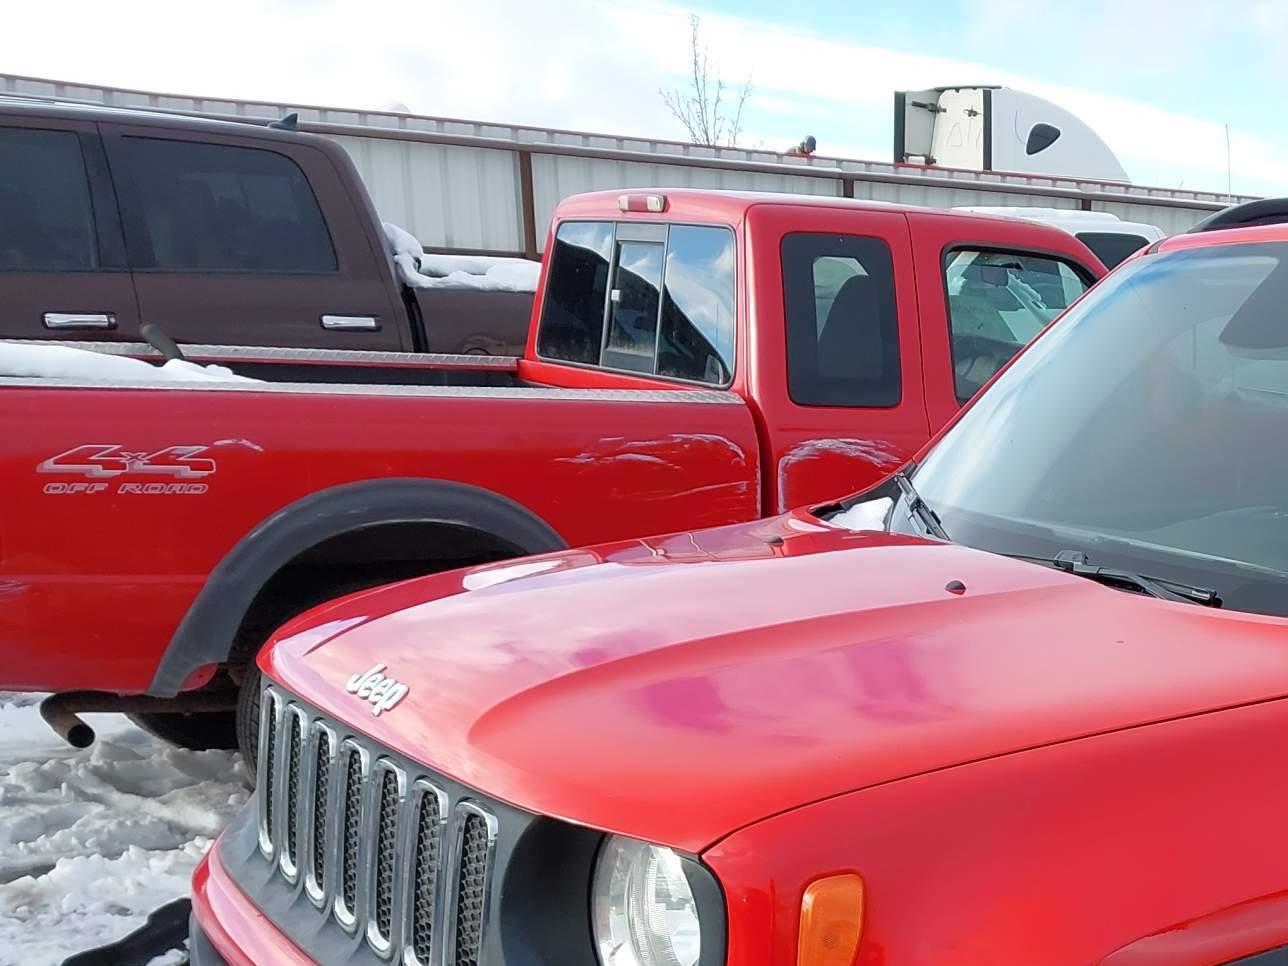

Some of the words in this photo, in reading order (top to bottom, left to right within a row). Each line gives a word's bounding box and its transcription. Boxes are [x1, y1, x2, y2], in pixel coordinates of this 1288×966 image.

[43, 482, 109, 495] OFF
[117, 482, 208, 495] ROAD
[345, 662, 411, 717] Jeep
